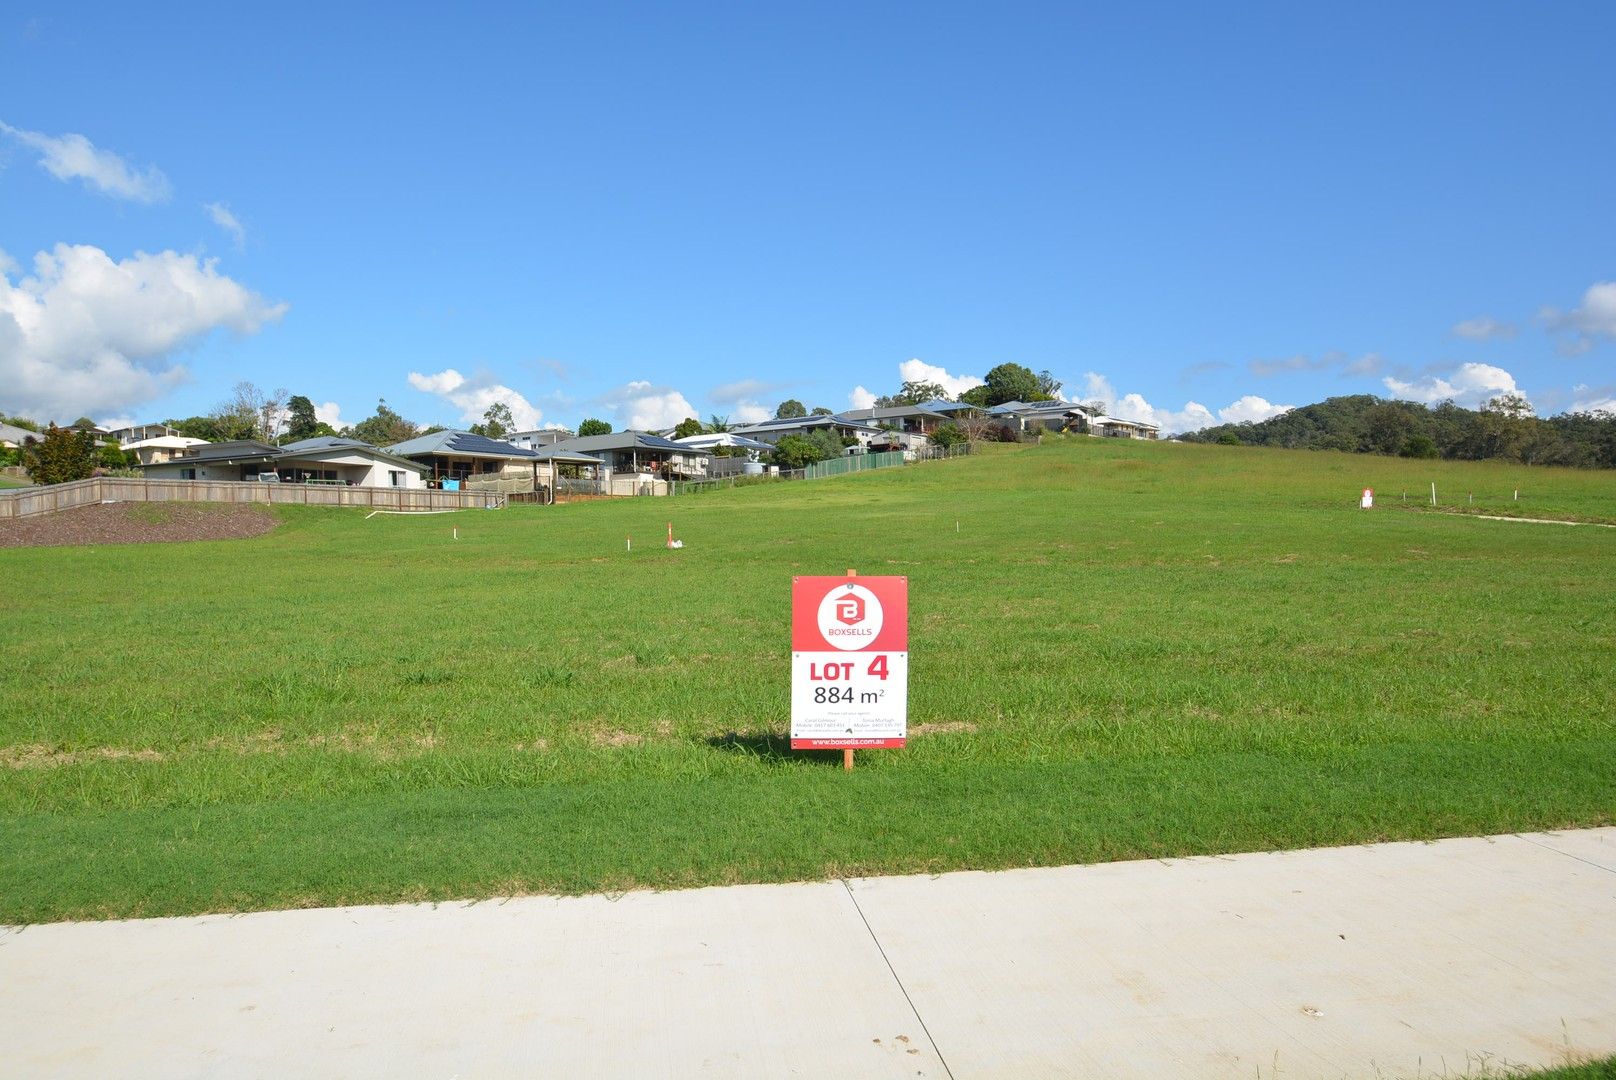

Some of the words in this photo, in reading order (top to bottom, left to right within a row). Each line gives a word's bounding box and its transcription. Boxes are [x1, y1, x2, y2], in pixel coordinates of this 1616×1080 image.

[828, 628, 872, 636] BOXSELLS
[810, 662, 855, 681] LOT
[867, 654, 889, 681] 4
[814, 686, 854, 704] 884
